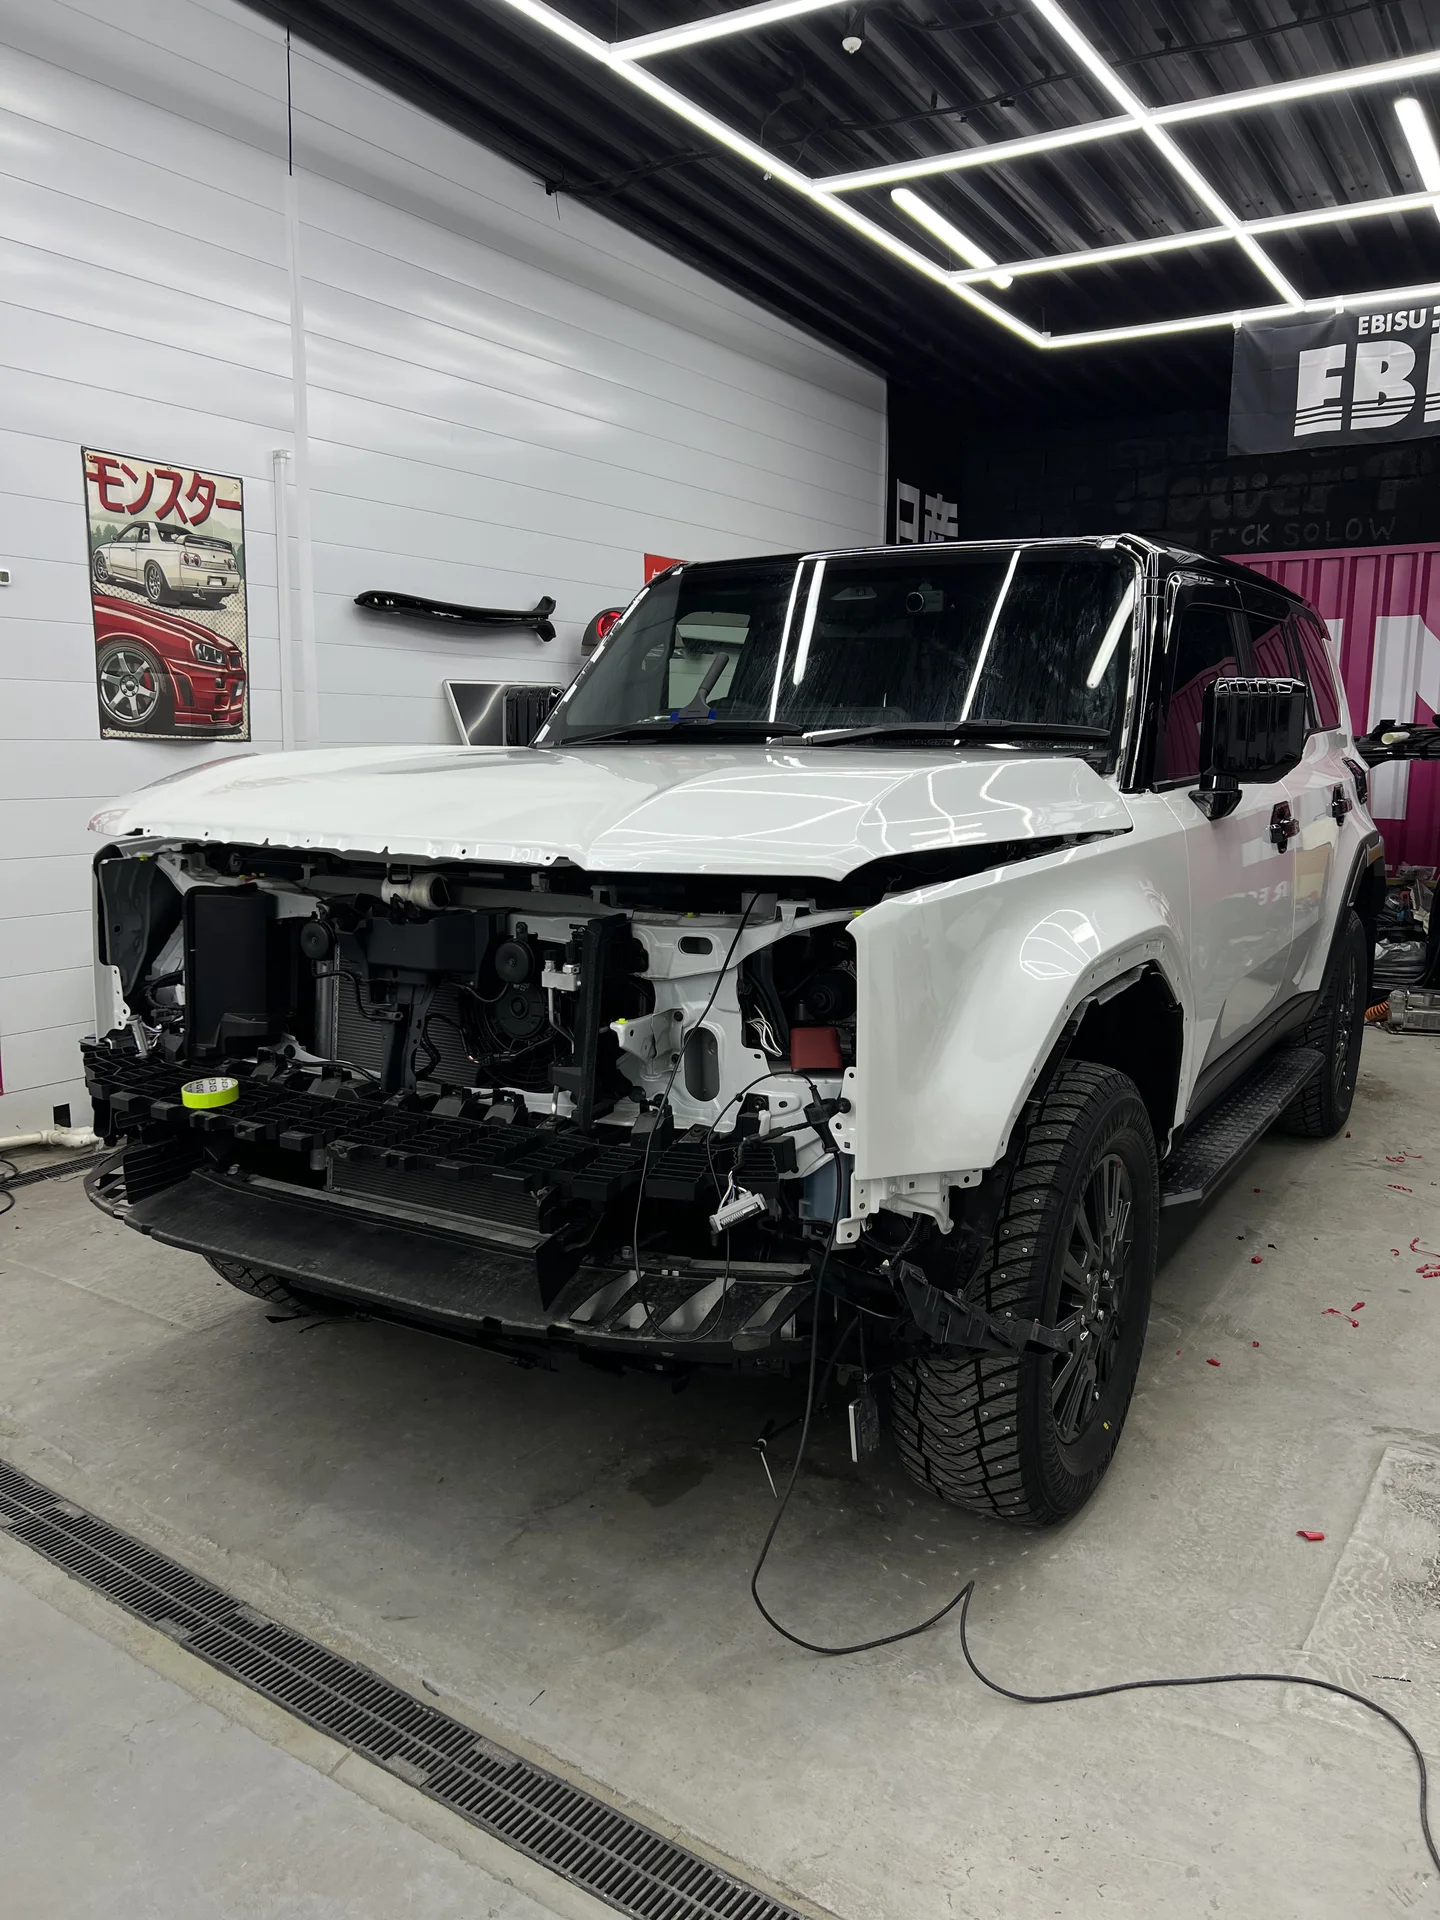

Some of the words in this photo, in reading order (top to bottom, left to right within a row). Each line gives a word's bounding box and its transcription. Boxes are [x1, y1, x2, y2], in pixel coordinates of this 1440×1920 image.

[1358, 308, 1427, 335] EBISU
[87, 456, 243, 526] モンスター
[1282, 516, 1397, 547] SOLOW
